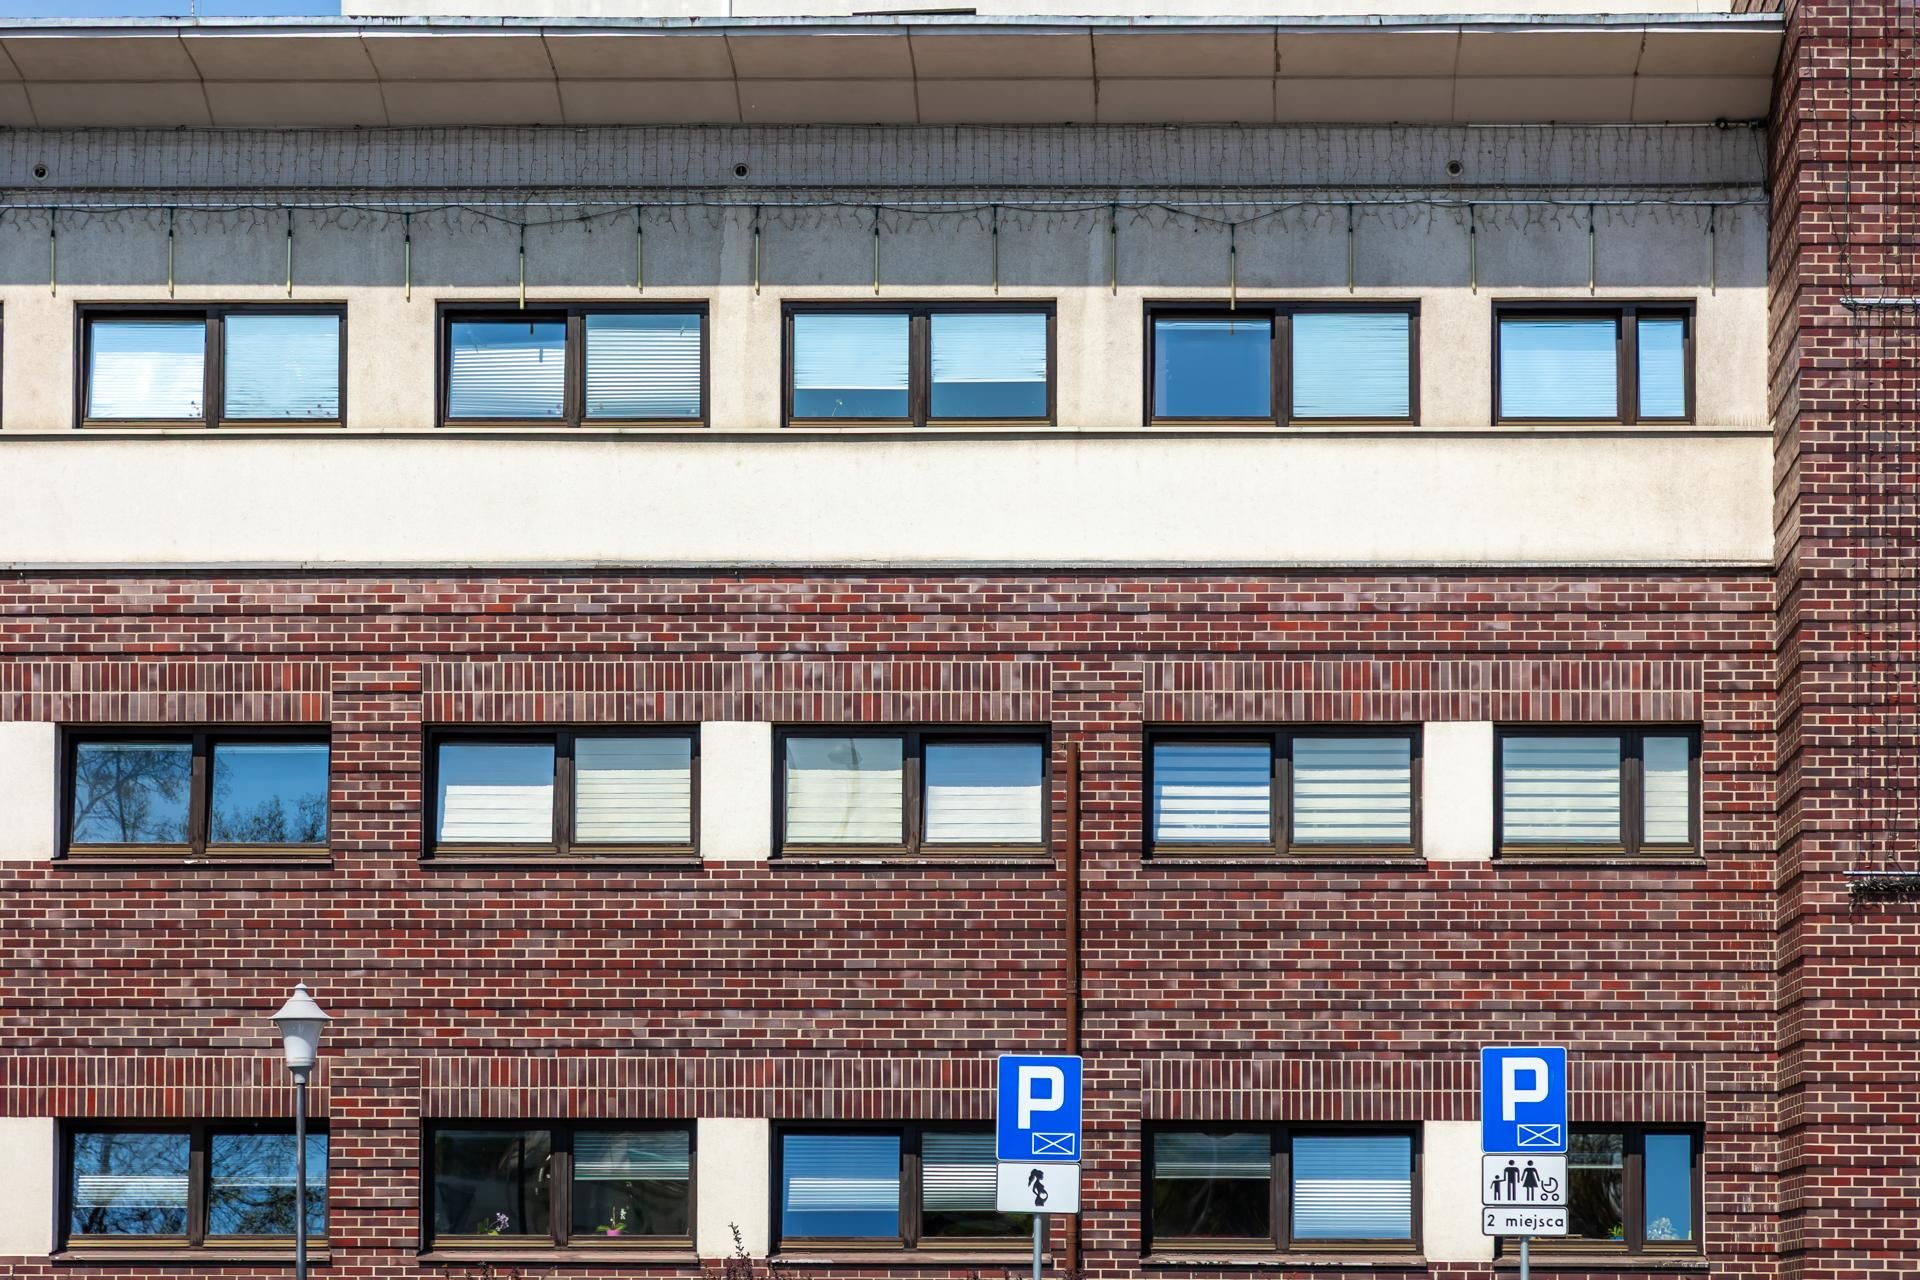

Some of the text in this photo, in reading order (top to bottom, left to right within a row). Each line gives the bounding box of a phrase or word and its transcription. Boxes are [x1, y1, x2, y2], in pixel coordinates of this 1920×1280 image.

[1018, 1066, 1064, 1129] P
[1502, 1057, 1548, 1121] P
[1487, 1214, 1564, 1231] 2 miejsca
